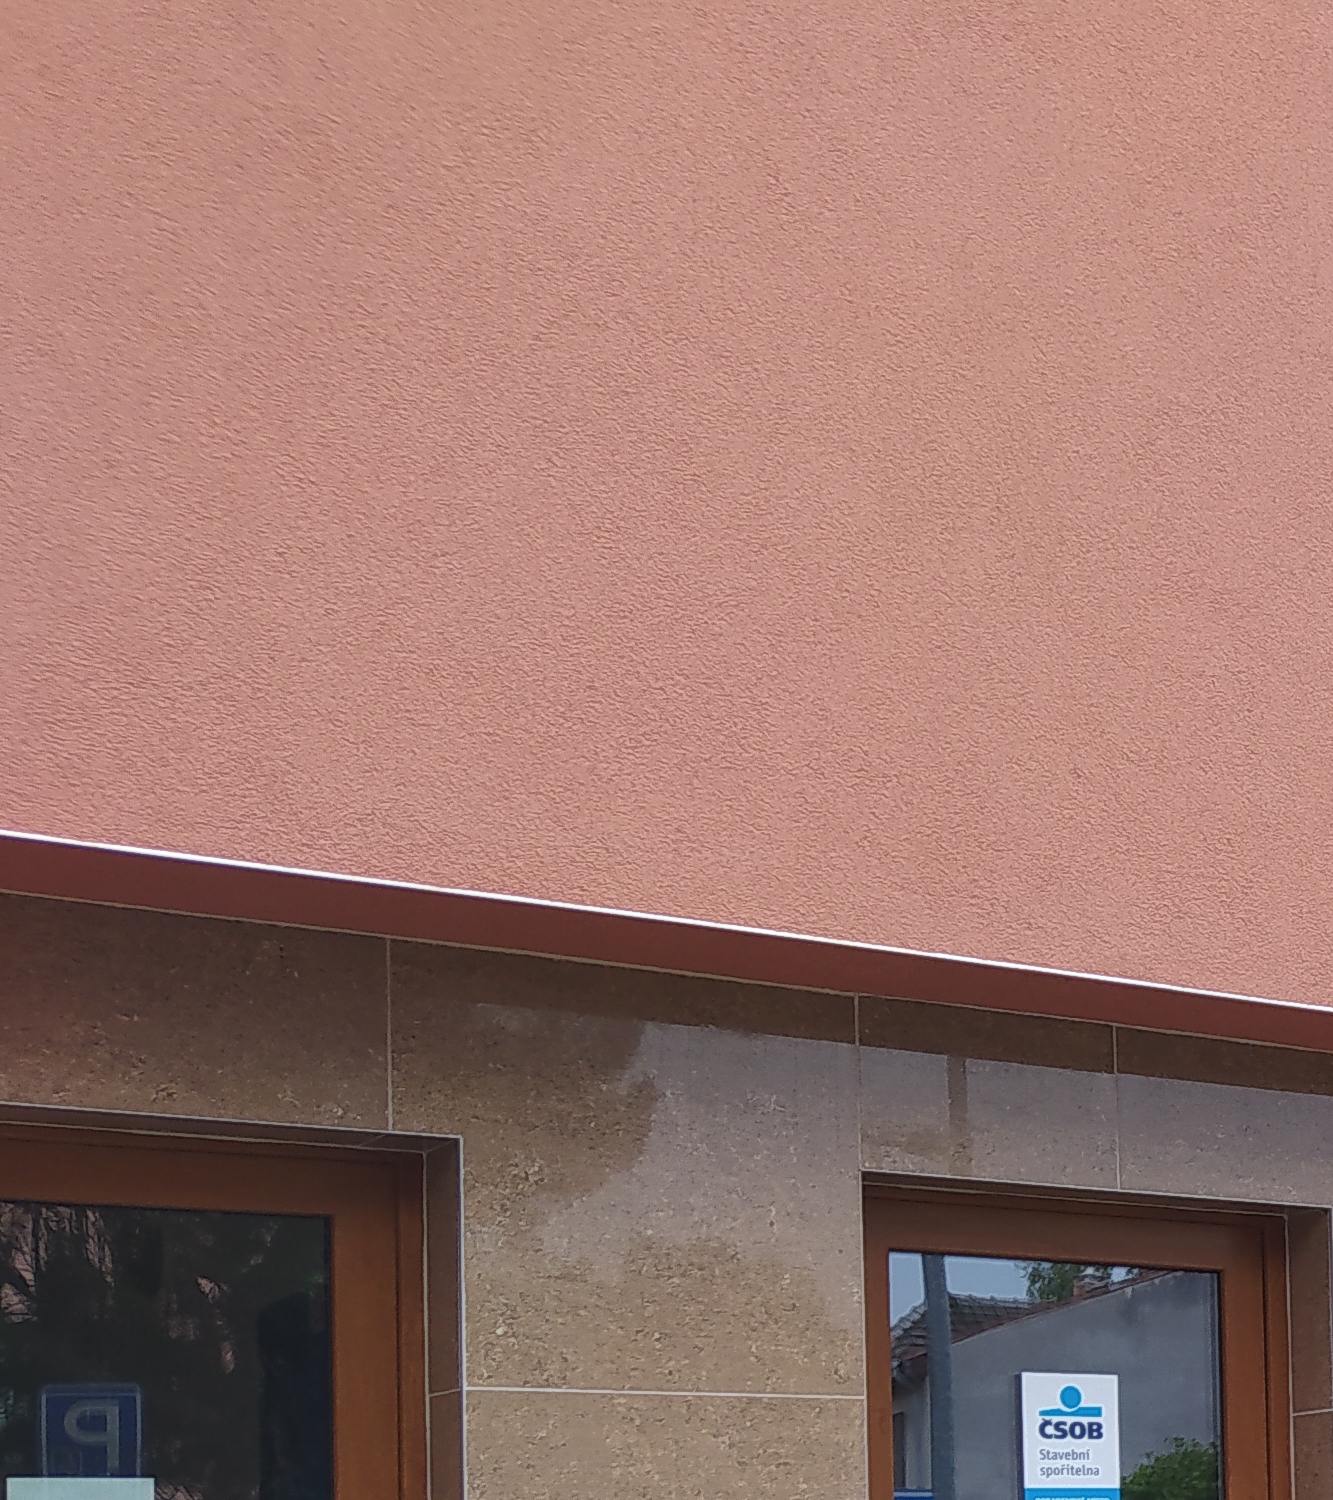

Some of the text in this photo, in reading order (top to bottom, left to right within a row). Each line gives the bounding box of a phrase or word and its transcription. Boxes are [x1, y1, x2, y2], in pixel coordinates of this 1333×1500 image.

[1038, 1418, 1104, 1440] ČSOB
[1039, 1448, 1091, 1461] Stavební
[1039, 1464, 1100, 1478] spořitelna
